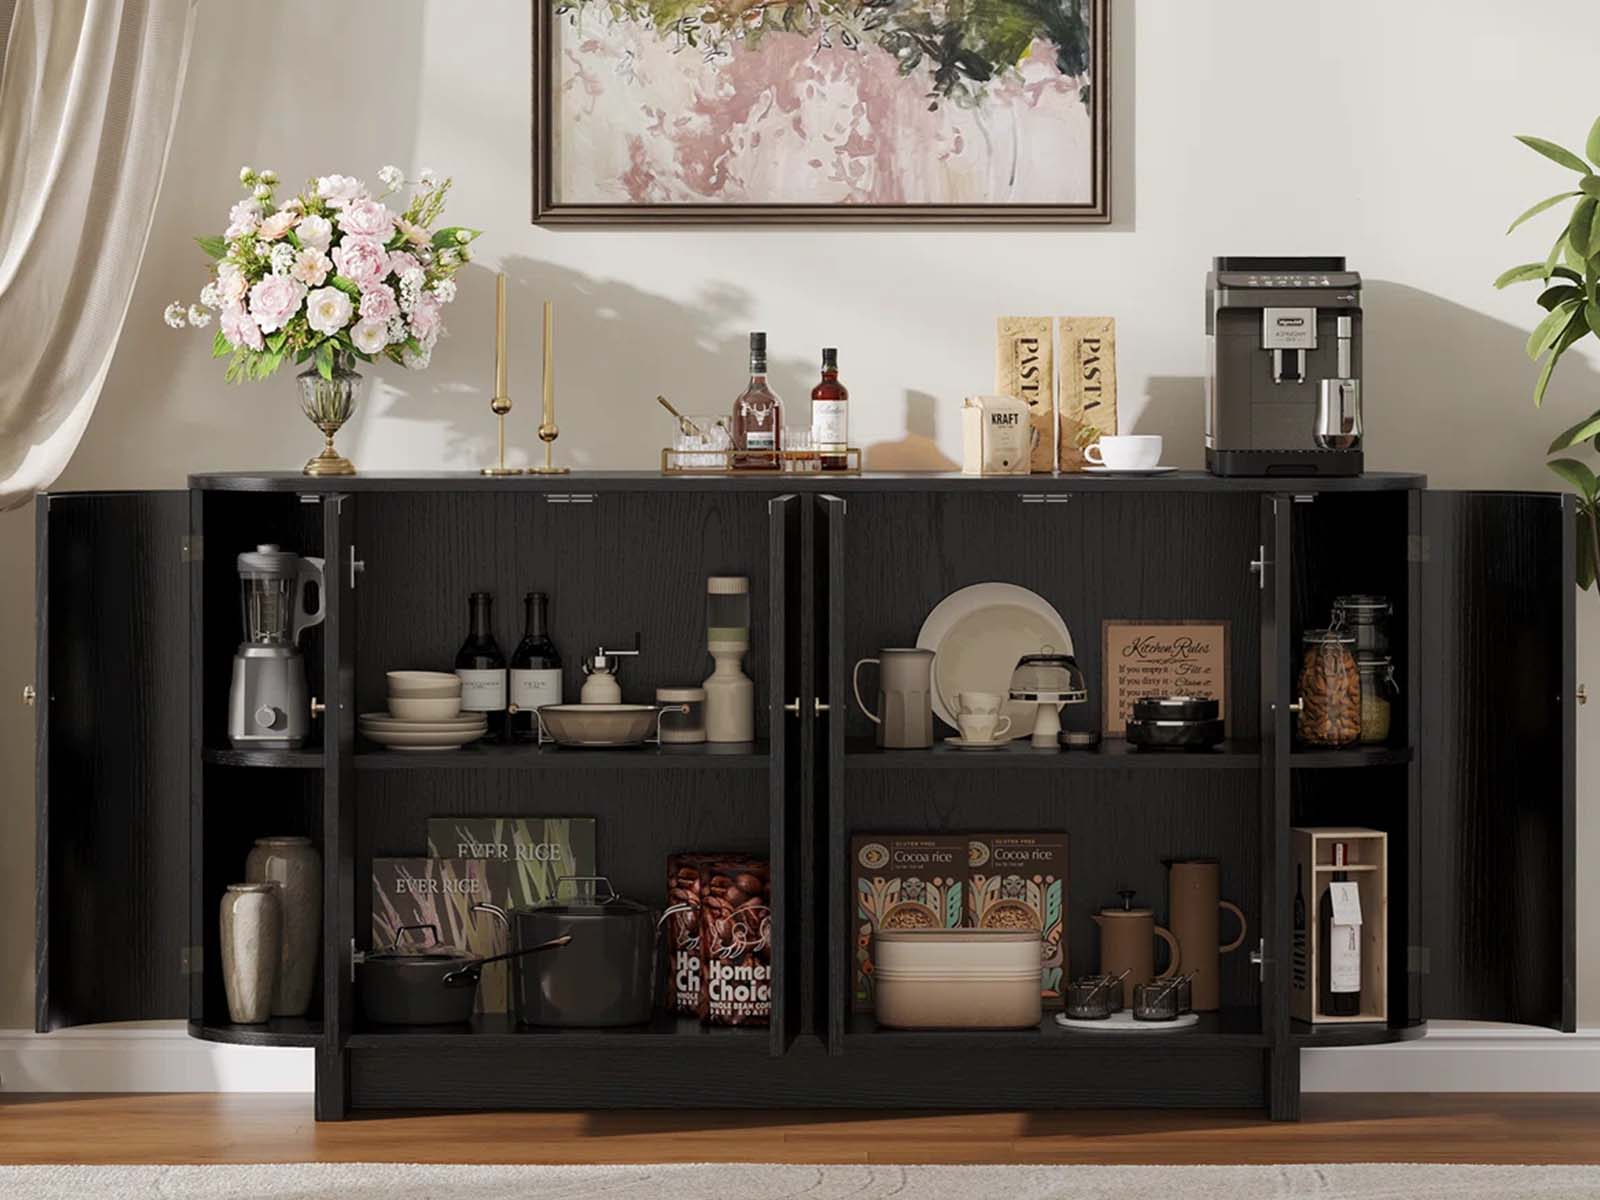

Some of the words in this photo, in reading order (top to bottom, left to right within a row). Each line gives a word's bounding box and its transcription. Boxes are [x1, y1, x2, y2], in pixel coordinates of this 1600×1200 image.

[1083, 338, 1102, 411] PASTA
[991, 413, 1019, 425] KRAFT
[1122, 635, 1172, 658] Kitchen
[1170, 636, 1210, 658] Rules
[457, 843, 508, 859] EVER
[514, 843, 562, 861] RICE
[894, 851, 929, 863] Cocoa
[931, 850, 953, 862] rice
[994, 849, 1029, 861] Cocoa
[1031, 848, 1053, 860] rice
[396, 878, 439, 894] EVER
[442, 878, 481, 894] RICE
[709, 1001, 732, 1009] WHOLE
